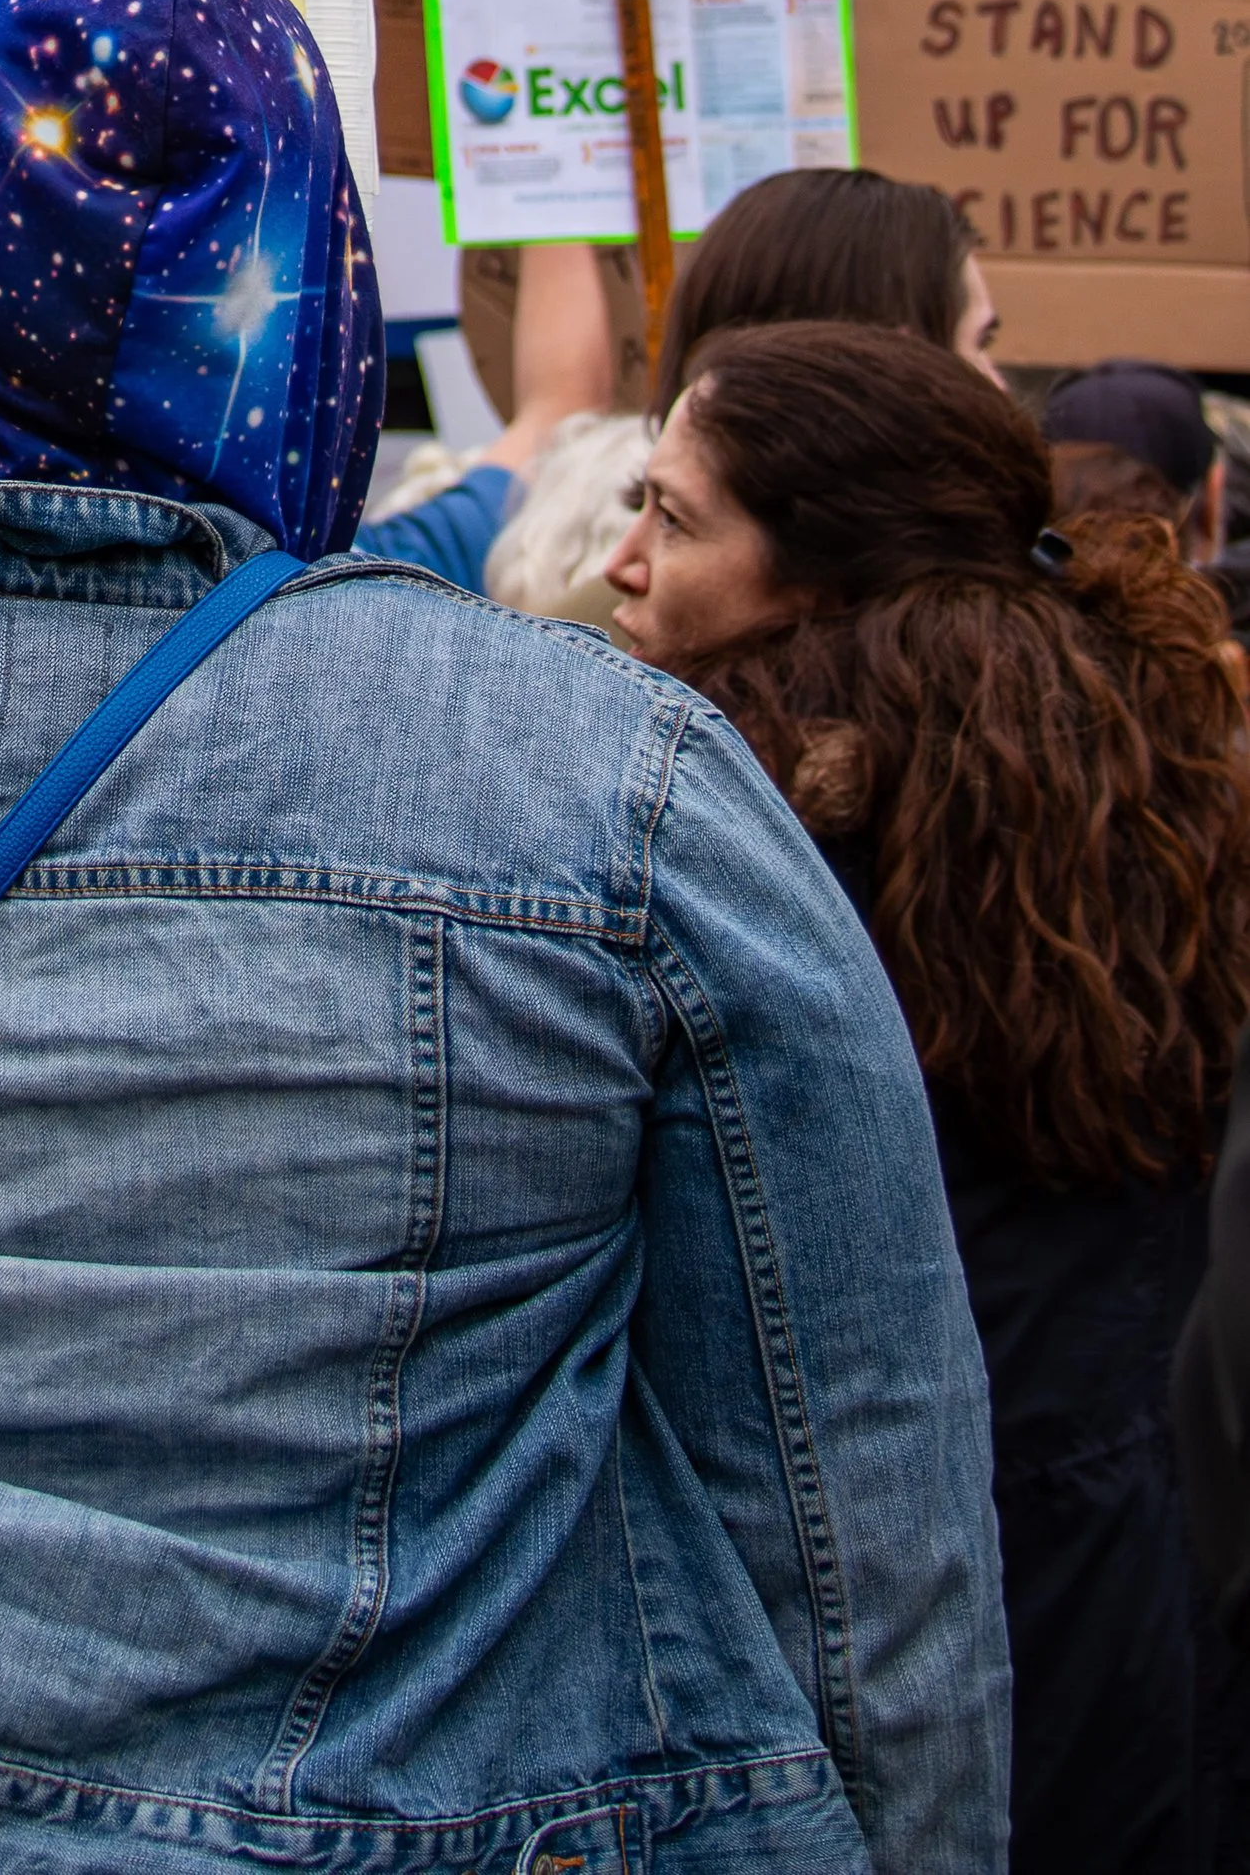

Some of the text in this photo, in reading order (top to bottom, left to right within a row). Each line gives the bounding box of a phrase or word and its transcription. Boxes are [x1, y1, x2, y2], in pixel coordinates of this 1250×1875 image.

[933, 91, 1189, 172] UP FOR
[952, 188, 1189, 251] CIENCE
